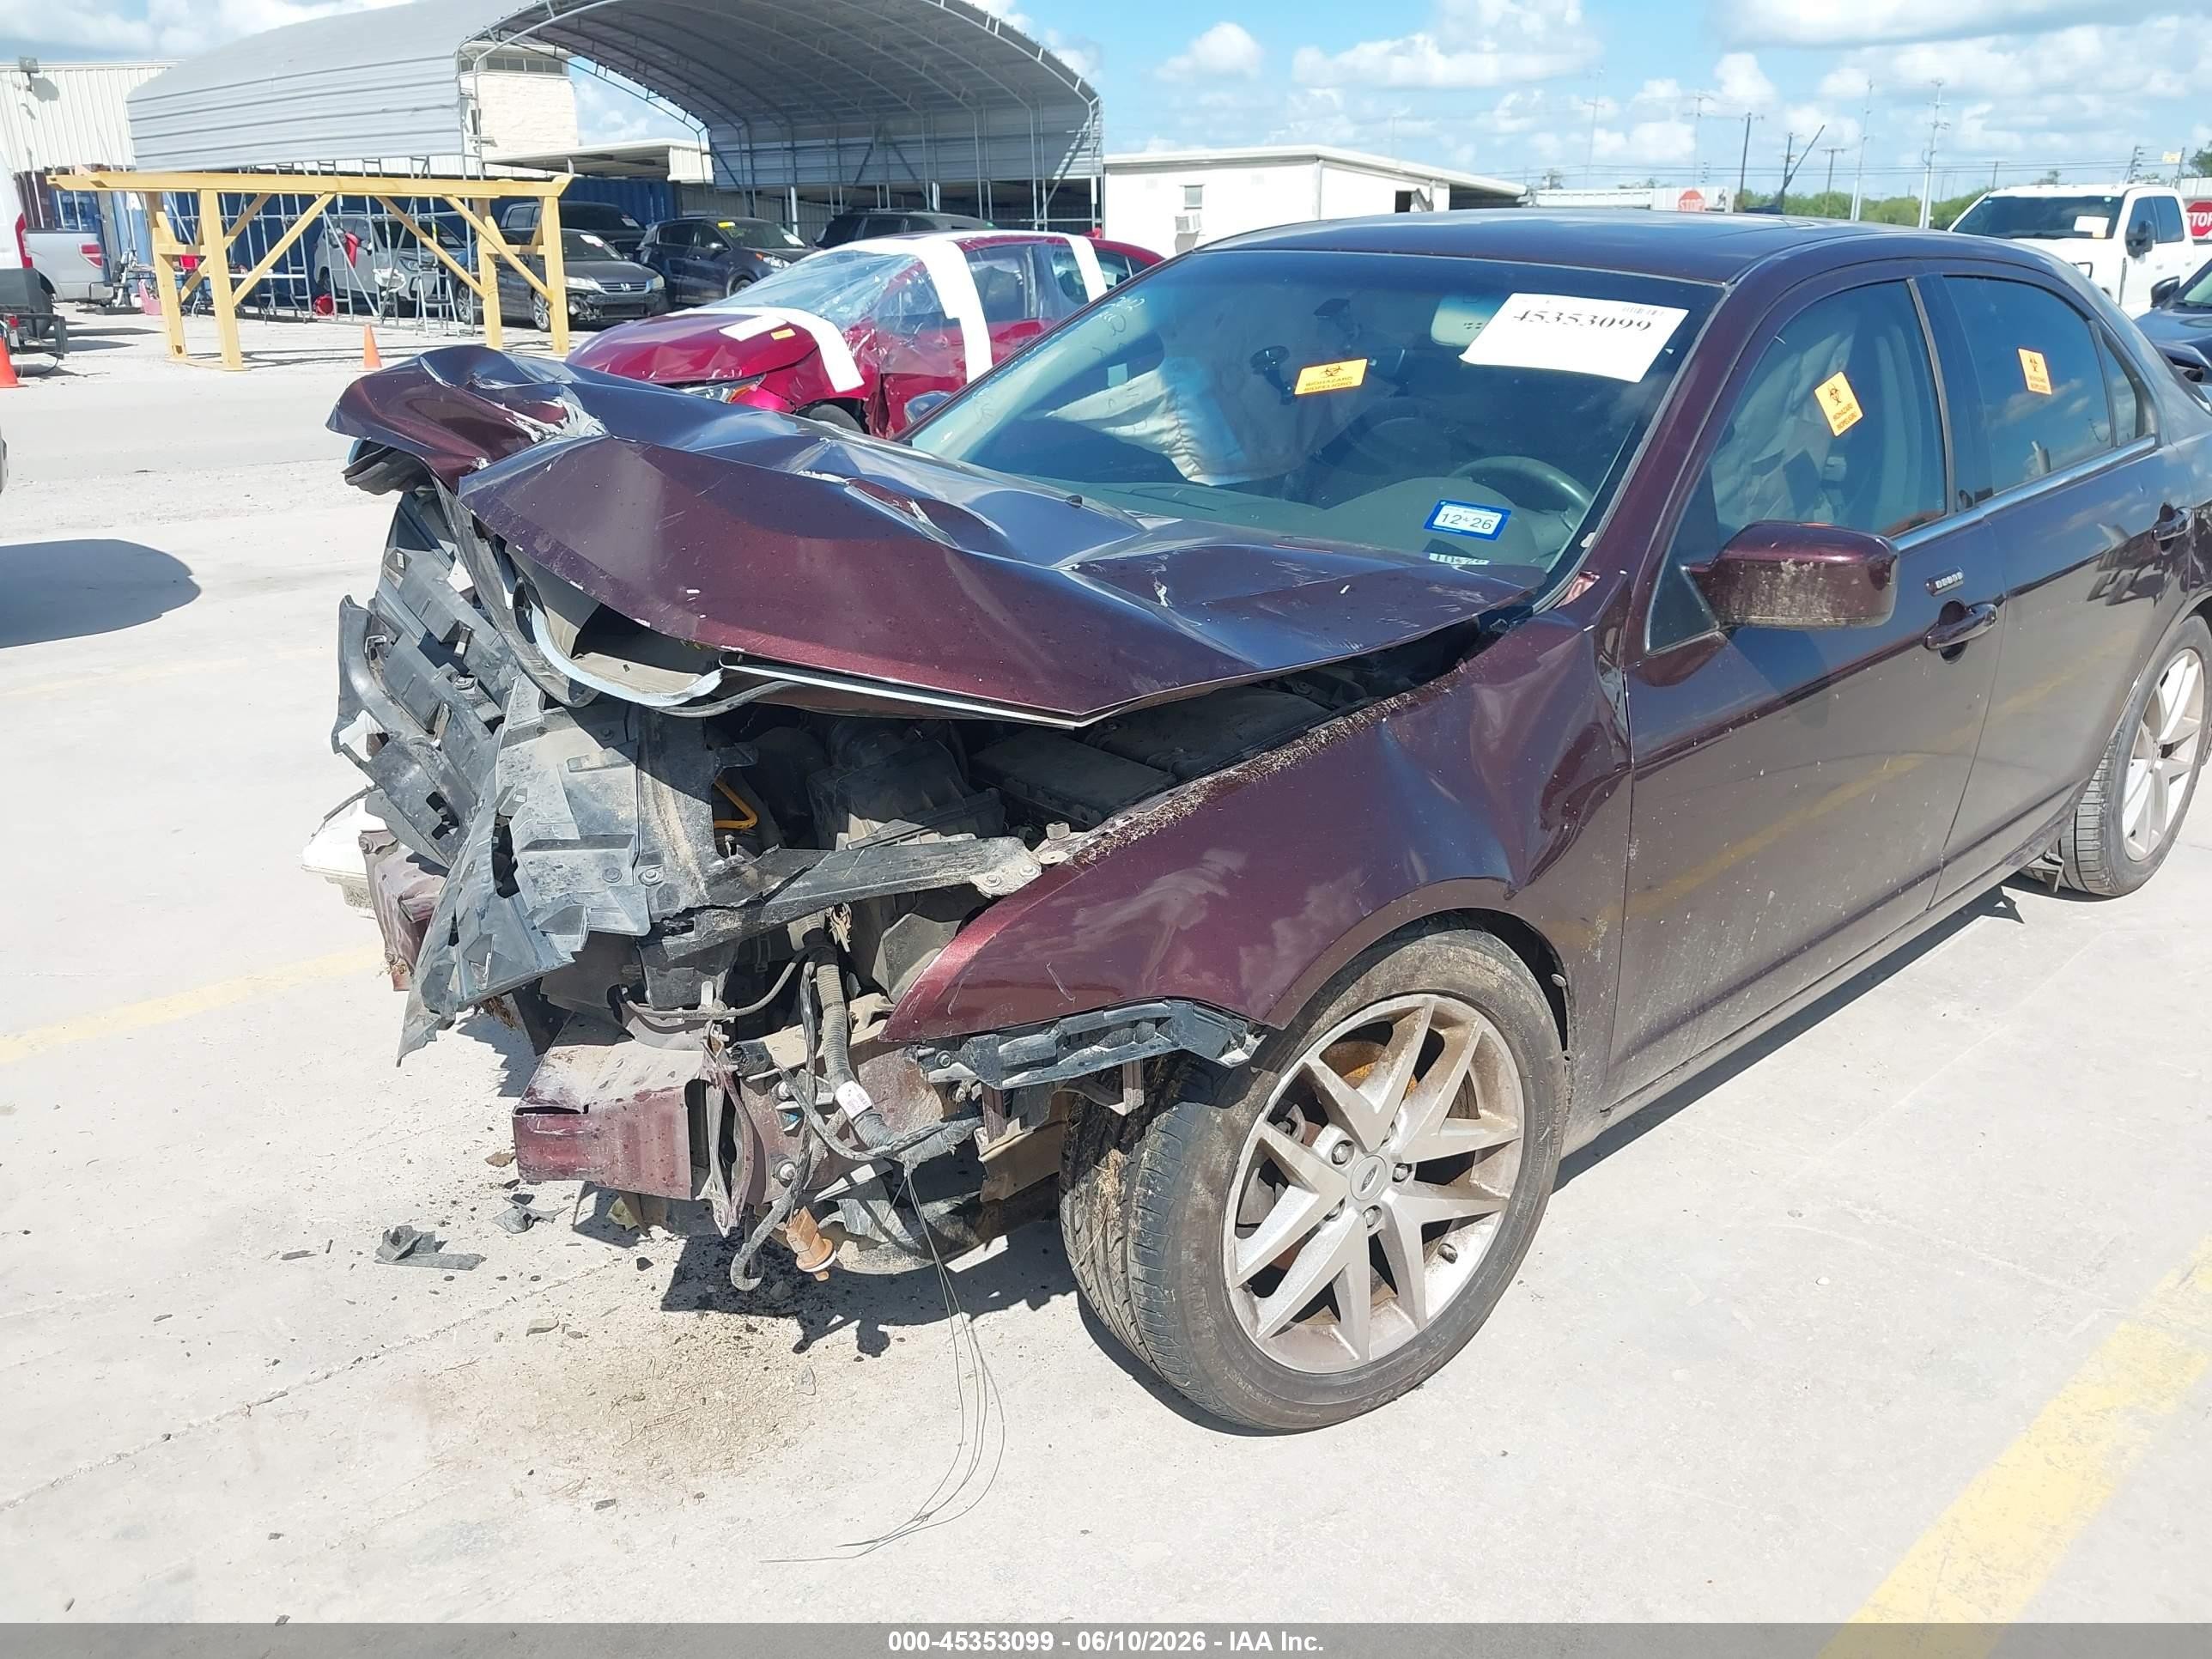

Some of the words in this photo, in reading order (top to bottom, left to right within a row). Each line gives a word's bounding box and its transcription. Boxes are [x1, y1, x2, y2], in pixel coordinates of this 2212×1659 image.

[1512, 309, 1652, 331] 45353099
[1442, 513, 1463, 526] 12
[1469, 517, 1494, 530] 26
